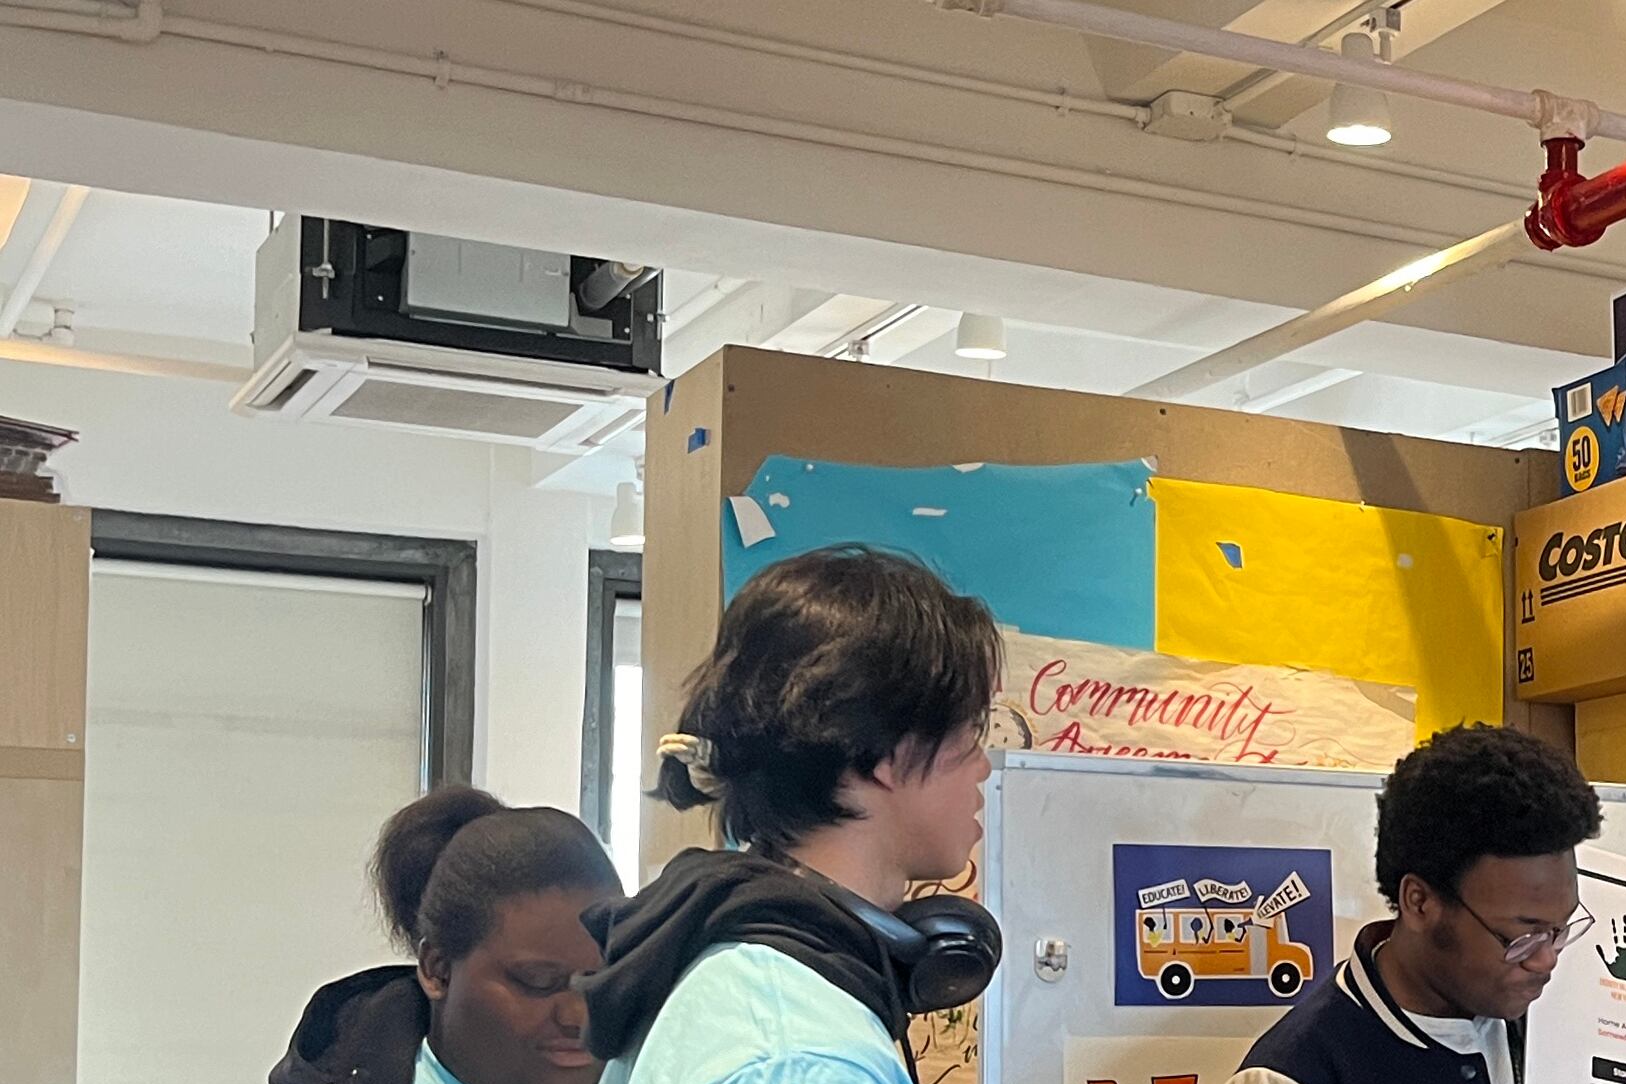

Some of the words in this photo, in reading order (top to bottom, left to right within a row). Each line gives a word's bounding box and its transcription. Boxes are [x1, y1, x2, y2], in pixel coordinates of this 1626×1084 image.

[1572, 436, 1592, 473] 50
[1520, 651, 1533, 681] 25
[1030, 659, 1297, 763] Community
[1142, 884, 1185, 905] EDUCATE!
[1198, 883, 1250, 903] LIBERATE!
[1598, 1017, 1620, 1029] Home
